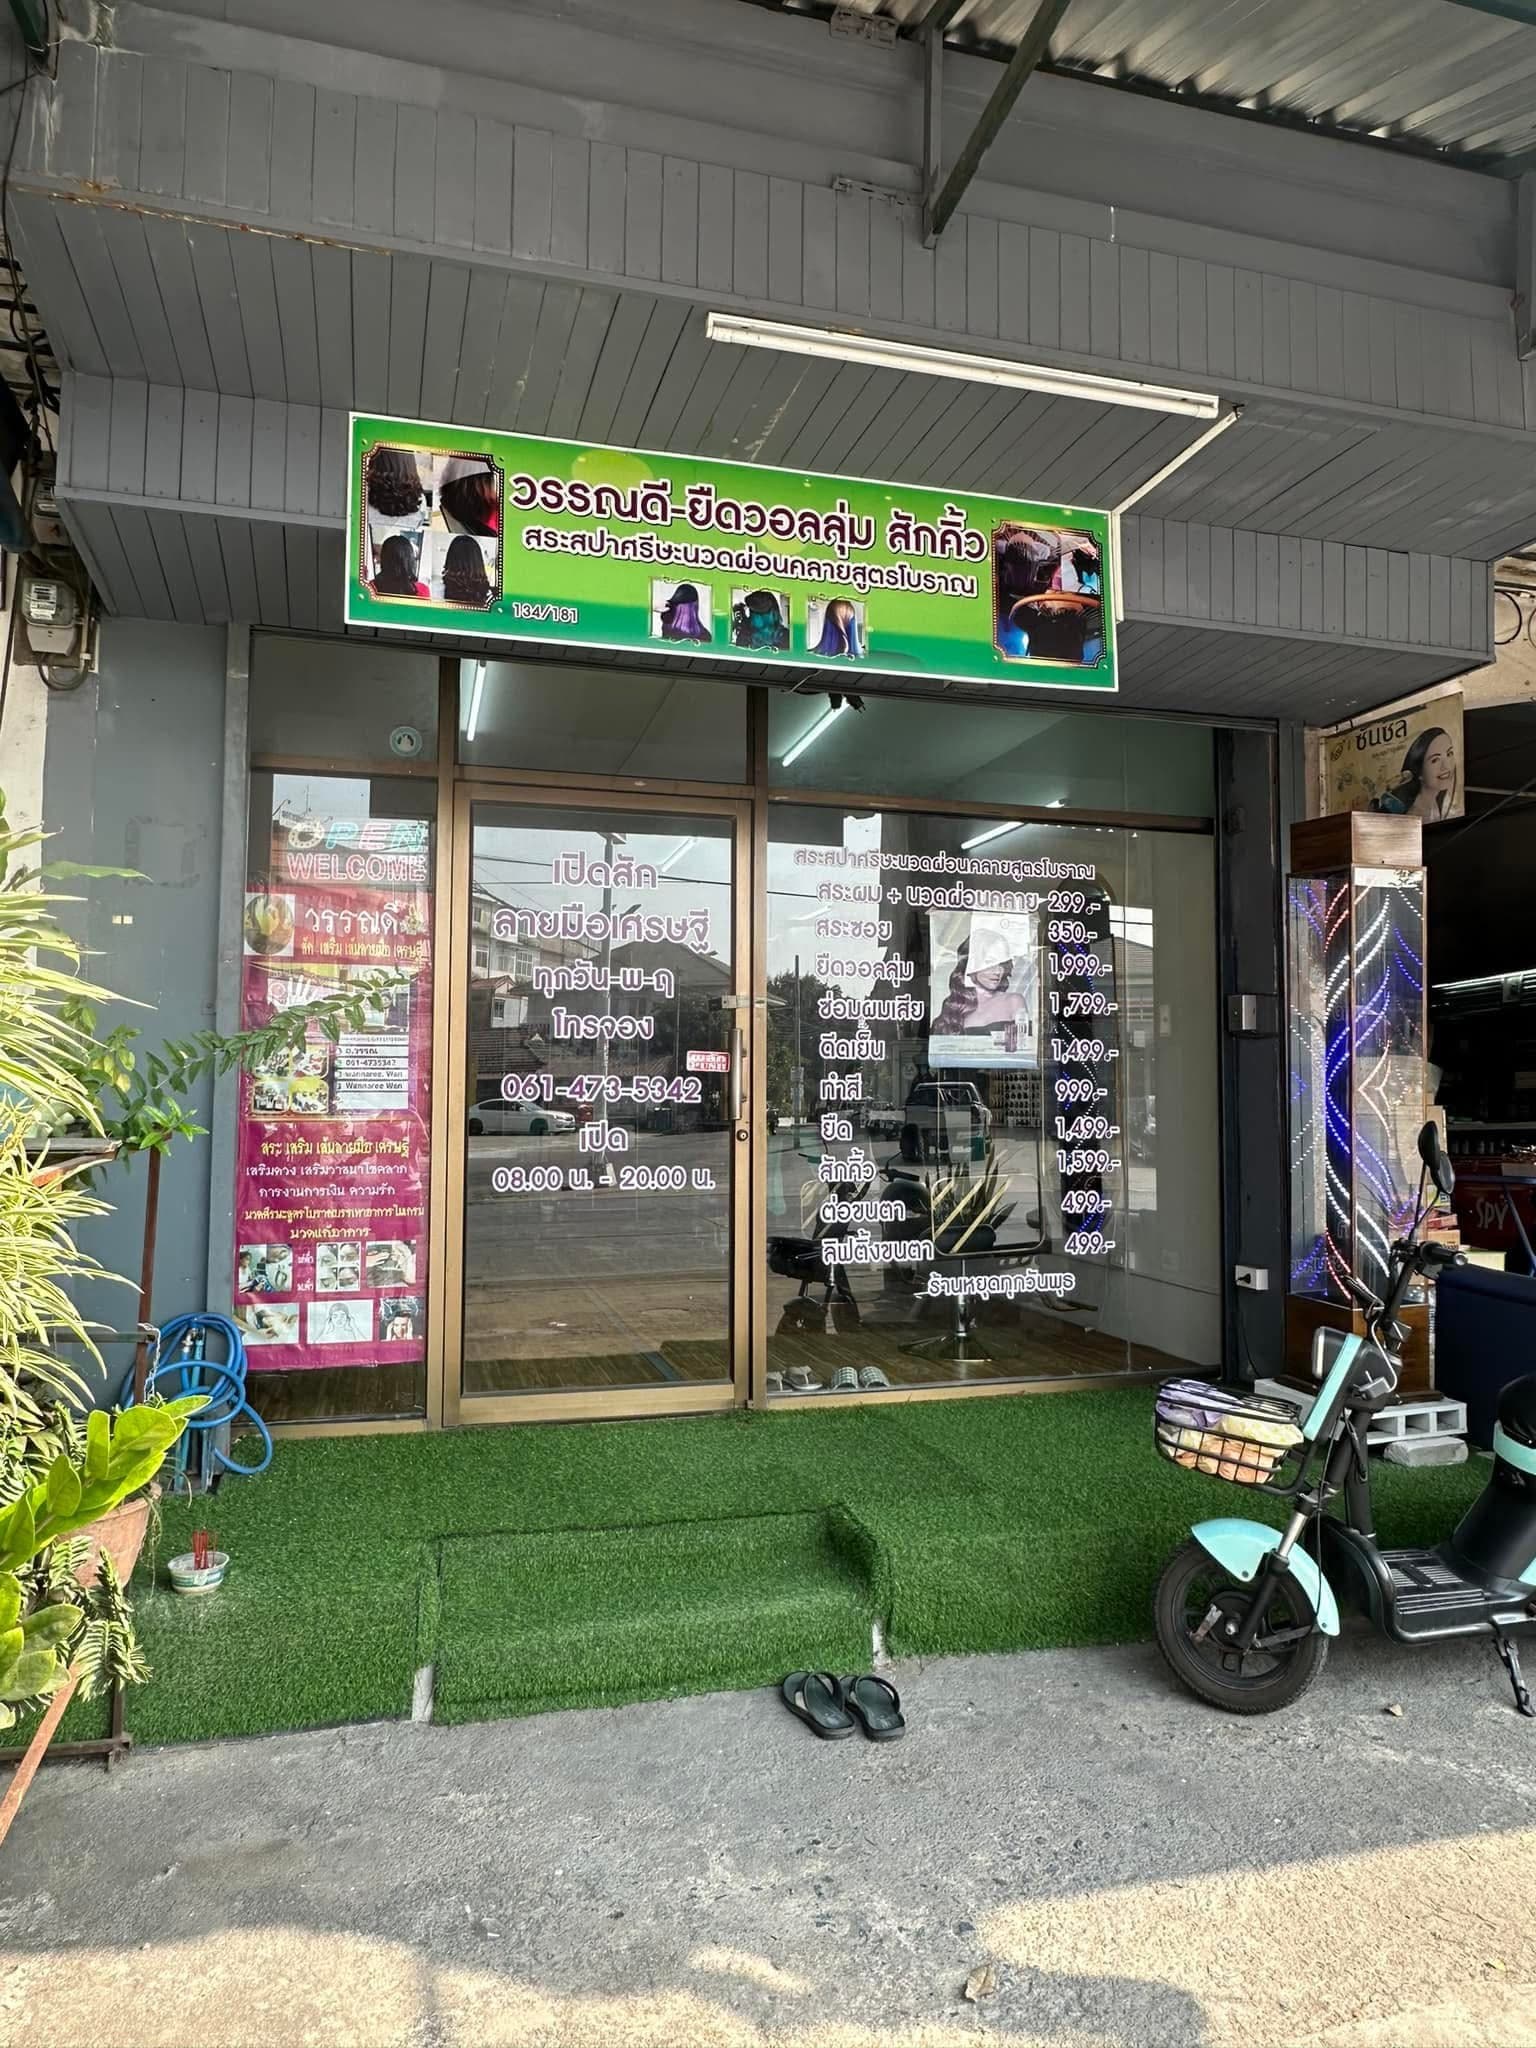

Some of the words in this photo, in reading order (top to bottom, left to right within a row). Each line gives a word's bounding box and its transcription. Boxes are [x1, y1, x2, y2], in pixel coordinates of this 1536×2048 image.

[510, 472, 873, 560] วรรณดี-ยืดวอลลุ่ม
[886, 503, 989, 565] สักคิ้ว
[523, 524, 979, 600] สระสปาศรีษะนวดผ่อนคลายสูตรโบราณ
[511, 601, 579, 625] 134/181
[287, 852, 427, 881] WELCOME
[552, 851, 659, 889] เปิดสัก
[794, 846, 1097, 881] สระสปาศรีษะนวดผ่อนคลายสูตรโบราณ
[817, 881, 882, 905] สระผม
[887, 889, 901, 903] +
[907, 881, 1040, 913] นวดผ่อนคลาย
[1047, 890, 1102, 915] 299.-
[494, 902, 711, 954] ลายมือเศรษฐี
[815, 918, 893, 942] สระซอย
[1048, 920, 1099, 944] 350.-
[532, 959, 675, 998] ทุกวัน-พ-ฤ
[816, 954, 915, 989] ยืดวอลลุ่ม
[1048, 952, 1113, 982] 1,999.-
[551, 1007, 654, 1039] โทรจอง
[818, 992, 925, 1023] ซ่อมผมเสีย
[1051, 1038, 1120, 1065] 1,499.-
[501, 1074, 702, 1102] 061-473-5342
[820, 1071, 863, 1100] ทำสี
[1055, 1079, 1108, 1102] 999.-
[579, 1120, 628, 1151] เปิด
[820, 1114, 853, 1141] ยืด
[1055, 1116, 1120, 1142] 1,499.-
[492, 1166, 564, 1192] 08.00
[569, 1169, 594, 1189] น.
[620, 1166, 687, 1189] 20.00
[691, 1168, 716, 1188] น.
[818, 1148, 877, 1183] สักคิ้ว
[1056, 1149, 1121, 1175] 1,599.-
[820, 1193, 906, 1223] ต่อขนตา
[1061, 1190, 1112, 1213] 499.-
[1476, 1197, 1509, 1230] SPY
[822, 1228, 934, 1265] ลิฟติ้งขนตา
[1065, 1231, 1116, 1254] 499.-
[927, 1267, 1076, 1300] ร้านหยุดทุกวันพุธ
